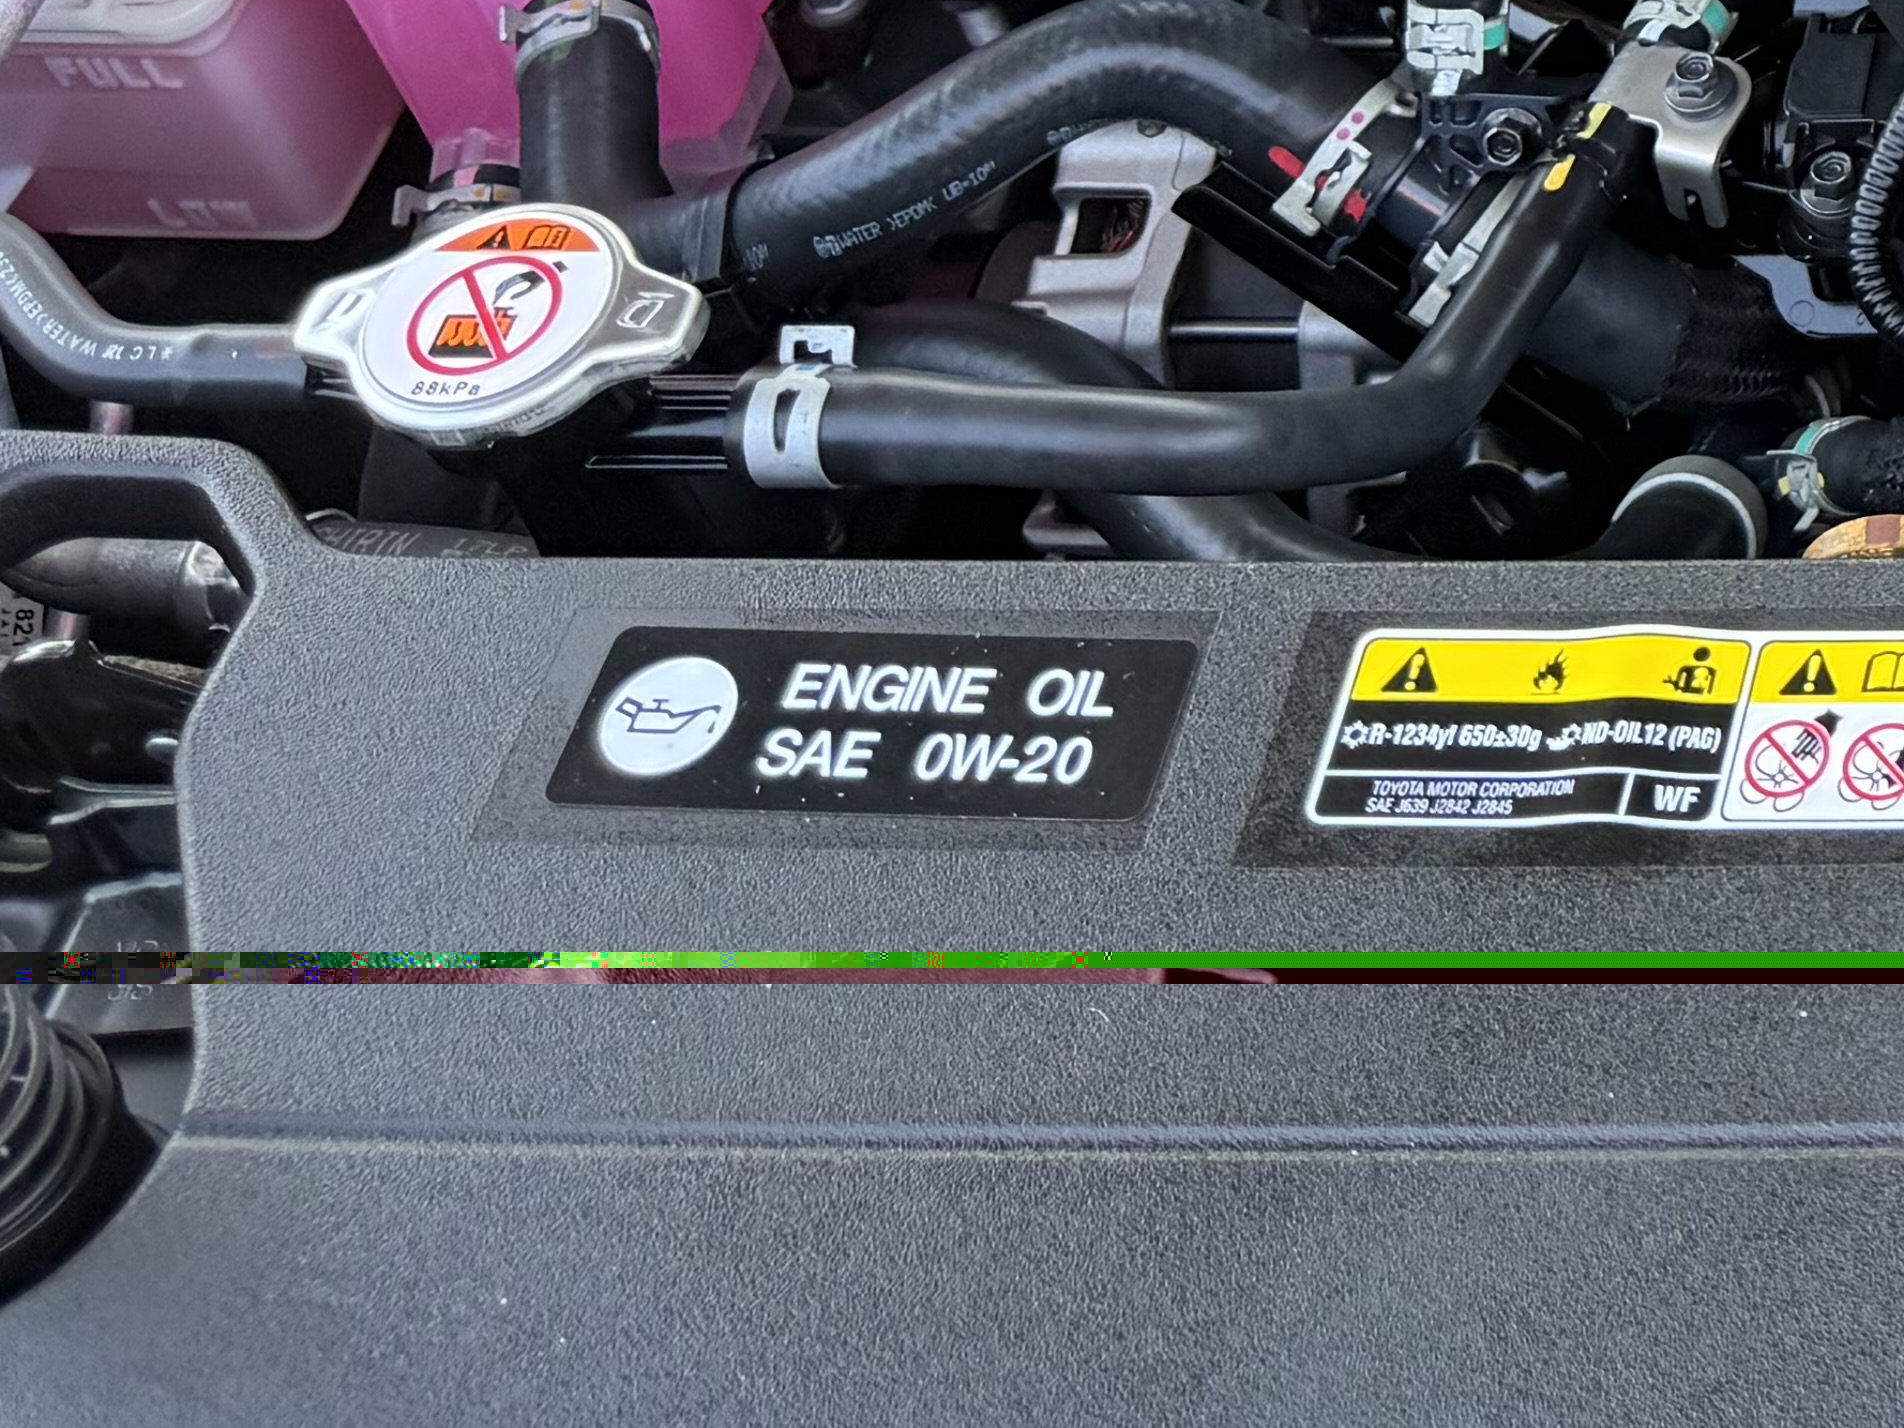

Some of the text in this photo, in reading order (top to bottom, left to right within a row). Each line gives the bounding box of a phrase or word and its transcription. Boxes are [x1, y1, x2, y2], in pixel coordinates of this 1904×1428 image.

[49, 57, 184, 90] FULL
[148, 196, 253, 232] LOW
[410, 380, 481, 397] 88kPa
[780, 663, 1115, 719] ENGINE OIL
[1368, 720, 1722, 754] R-1234yf 650±30g ND-OIL12 (PAG)
[756, 729, 1094, 785] SAE 0W-20
[1372, 778, 1575, 797] TOYOTA MOTOR CORPORATION
[1653, 785, 1702, 814] WF
[1365, 799, 1513, 815] SAE J639 J2842 J2845
